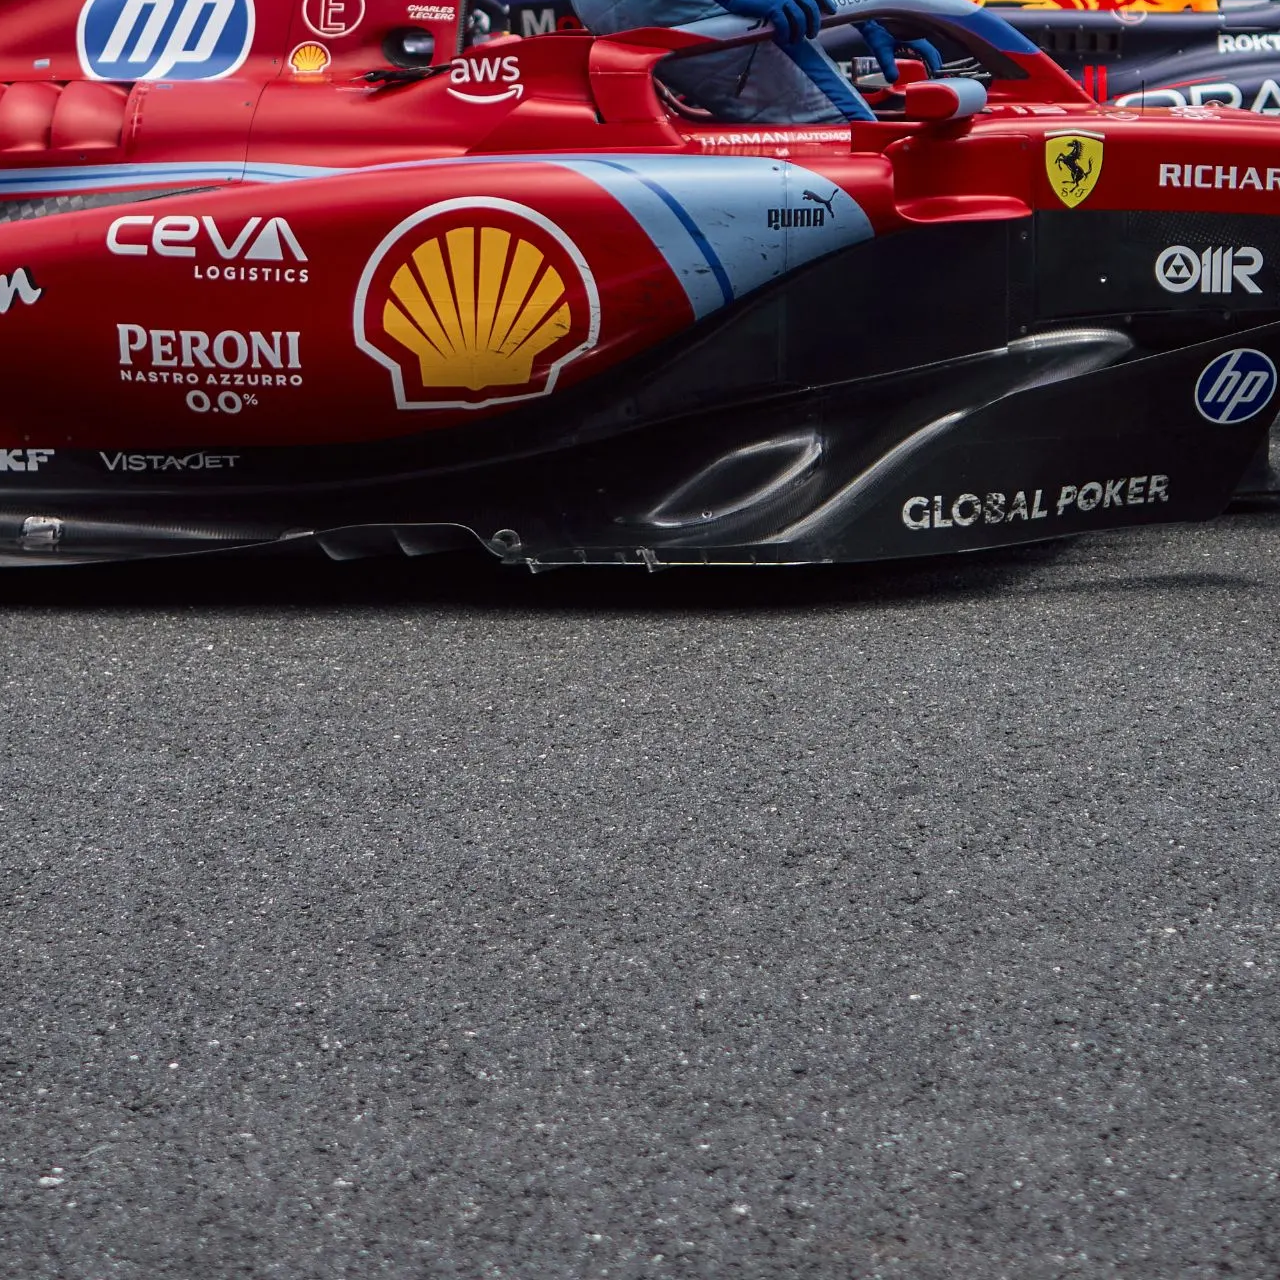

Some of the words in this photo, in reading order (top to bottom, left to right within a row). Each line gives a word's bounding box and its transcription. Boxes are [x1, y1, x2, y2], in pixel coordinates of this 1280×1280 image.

[407, 4, 455, 14] CHARLES
[409, 11, 456, 21] LECLERC
[451, 55, 520, 84] aws
[700, 131, 789, 147] HARMAN
[767, 208, 825, 228] PUMA
[194, 265, 309, 283] LOGISTICS
[117, 323, 302, 369] PERONI
[120, 370, 199, 384] NASTRO
[206, 373, 303, 386] AZZURRO
[1203, 349, 1269, 424] hp
[186, 389, 259, 414] 0.0%
[901, 488, 1048, 530] GLOBAL
[1056, 473, 1170, 518] POKER
